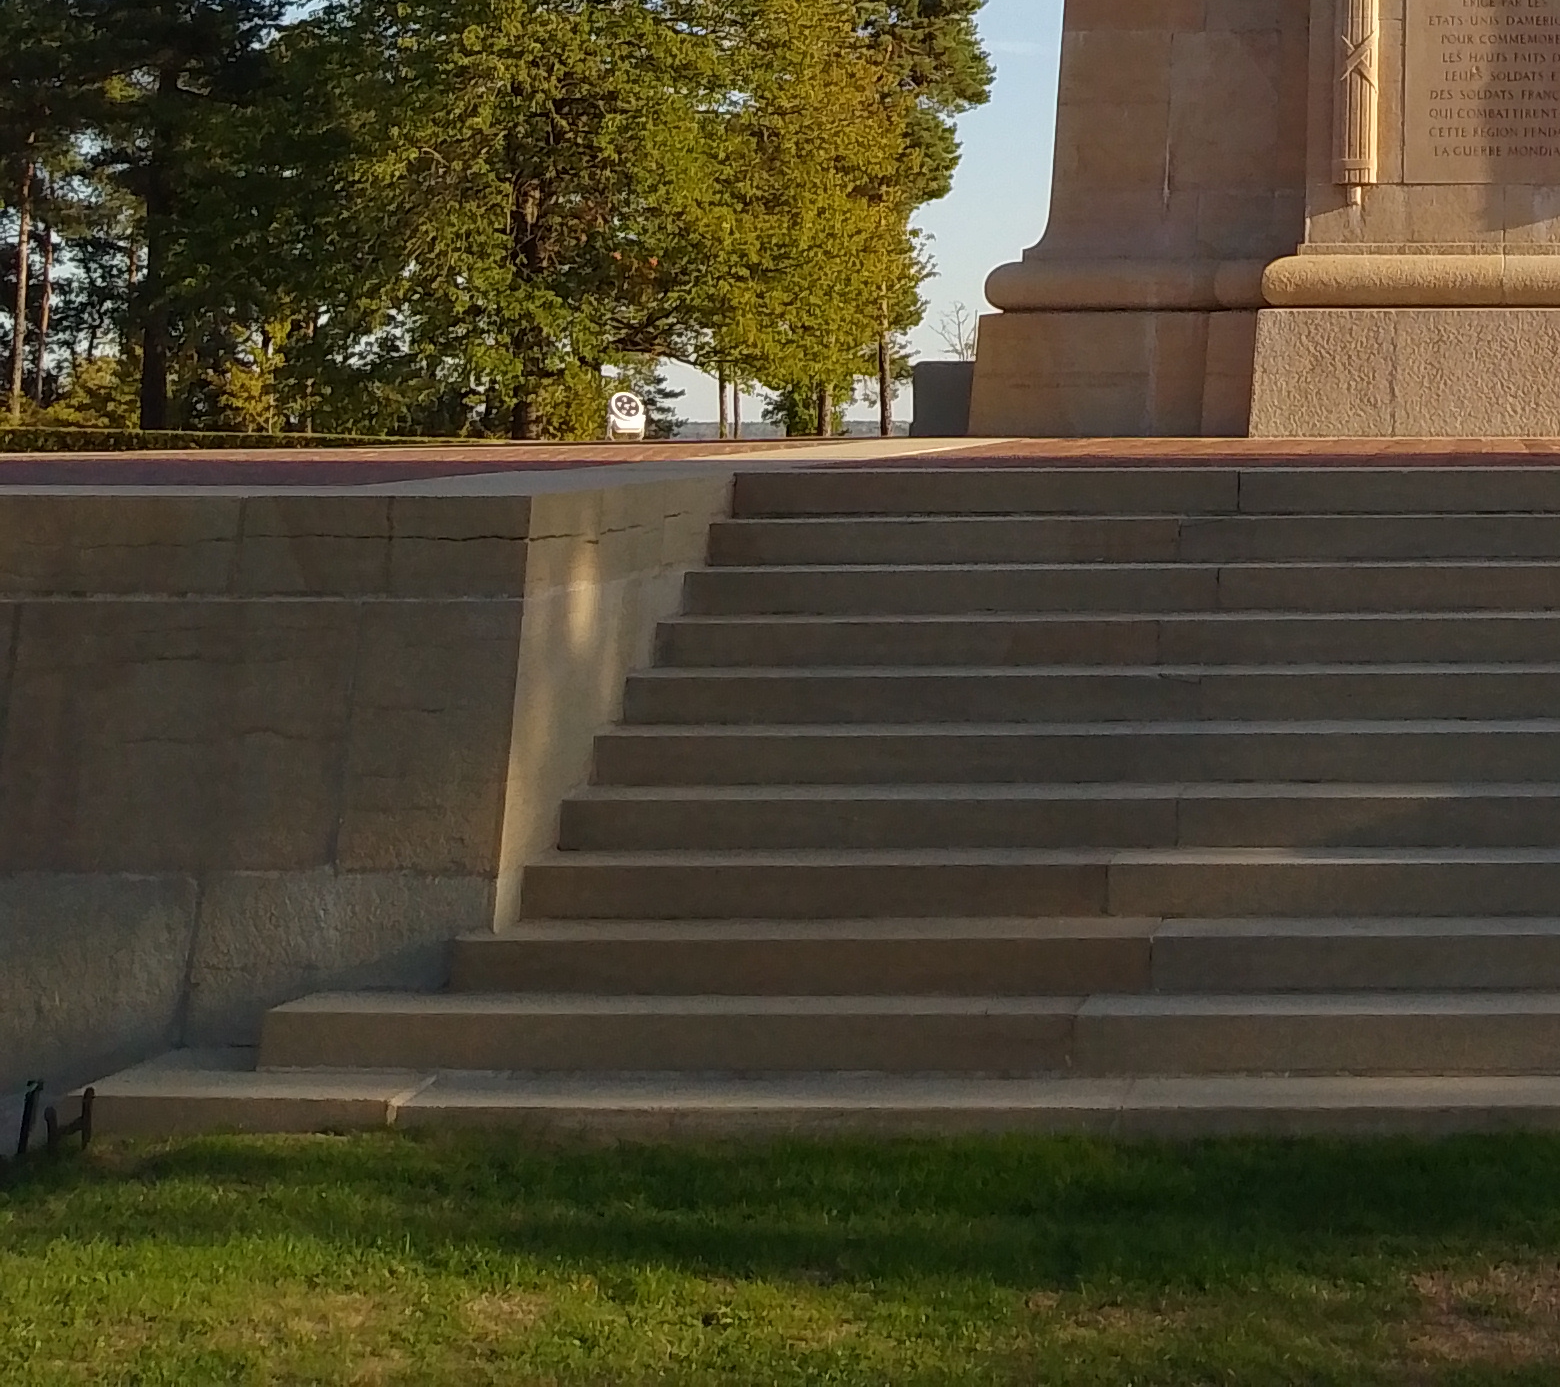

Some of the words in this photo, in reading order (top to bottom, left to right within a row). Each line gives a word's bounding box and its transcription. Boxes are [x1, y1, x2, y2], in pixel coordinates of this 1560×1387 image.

[1441, 34, 1473, 44] POUR
[1442, 53, 1462, 63] LES
[1469, 53, 1507, 63] HAUTS
[1514, 53, 1546, 63] FAITS
[1490, 71, 1543, 82] SOLDATS
[1430, 90, 1453, 101] DES
[1460, 90, 1514, 101] SOLDATS
[1429, 109, 1453, 119] QUI
[1457, 109, 1557, 119] COMBATTIRENT
[1429, 127, 1467, 138] CETTE
[1434, 146, 1449, 156] LA
[1453, 146, 1502, 156] GUERRE
